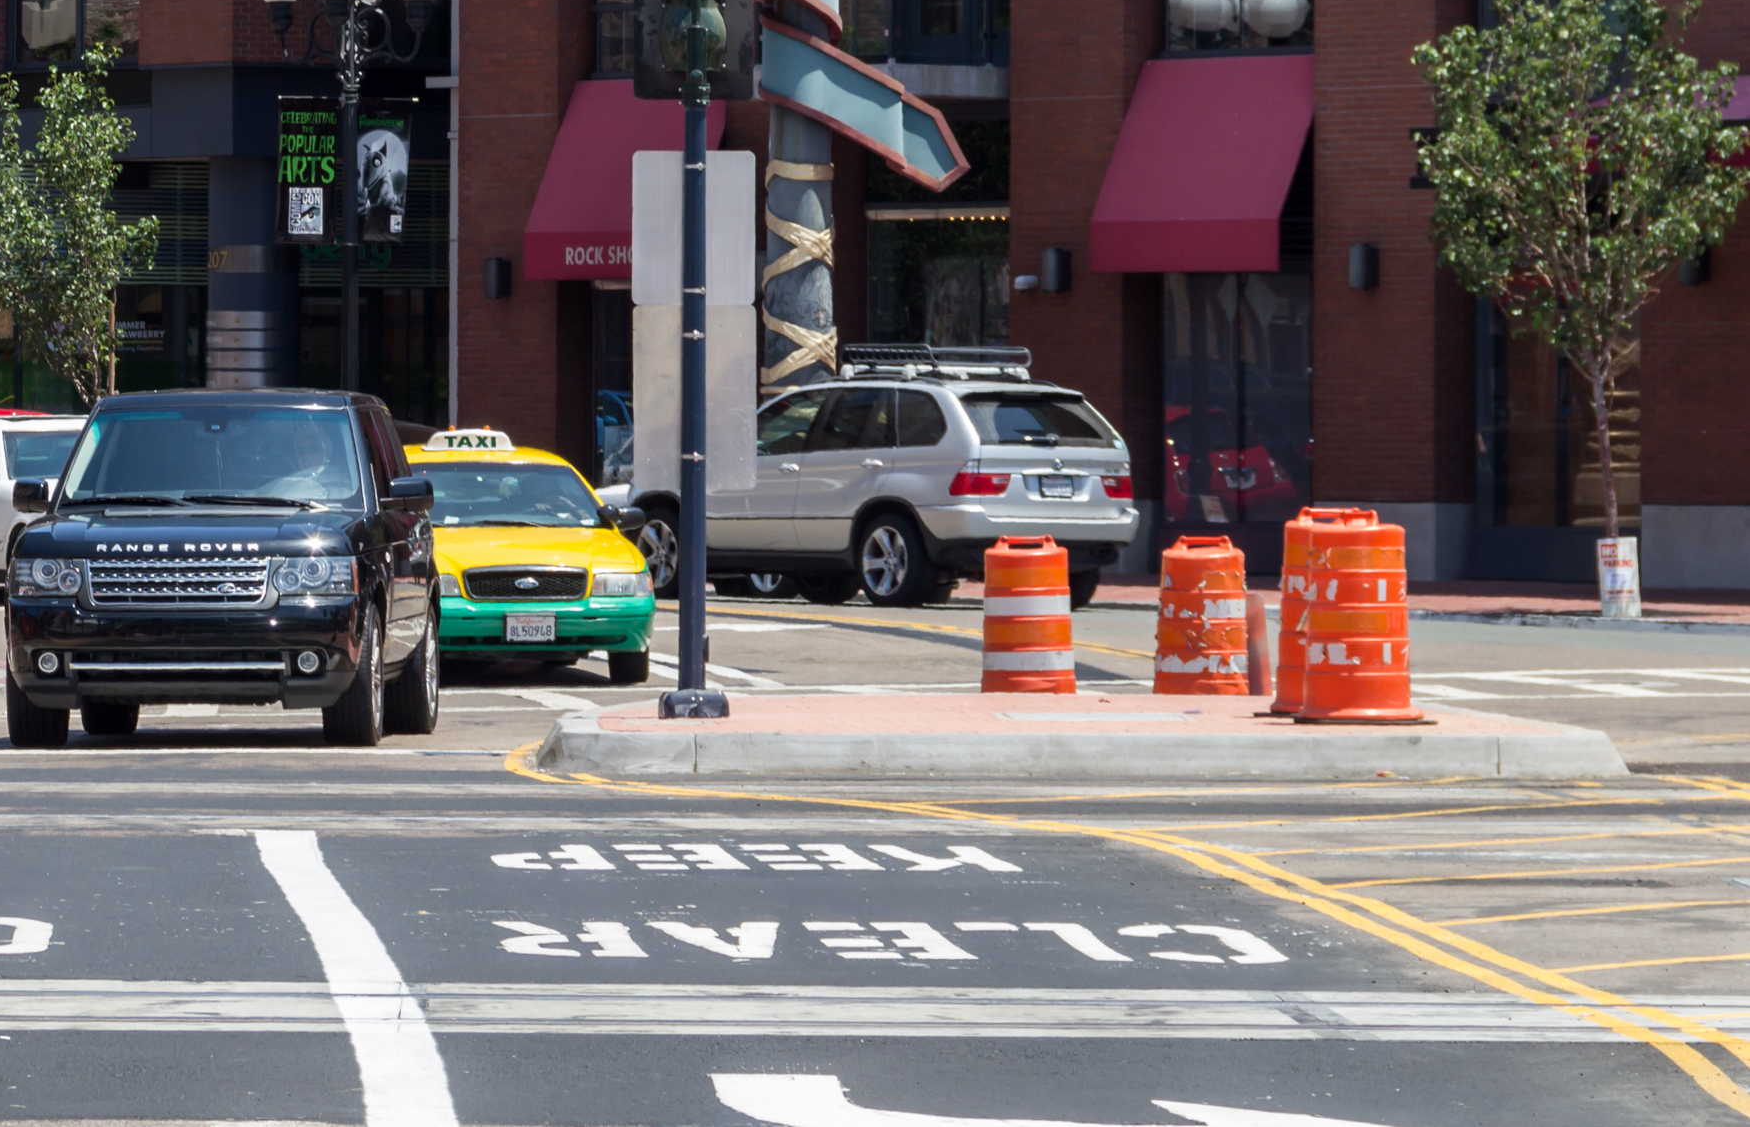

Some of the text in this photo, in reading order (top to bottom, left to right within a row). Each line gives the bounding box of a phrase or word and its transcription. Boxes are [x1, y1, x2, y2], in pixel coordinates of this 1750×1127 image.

[280, 112, 337, 124] CELEBRATING
[302, 126, 313, 134] THE
[279, 135, 336, 154] POPULAR
[278, 156, 336, 184] ARTS
[302, 192, 321, 204] CON
[290, 192, 301, 227] COMIC
[565, 246, 604, 265] ROCK
[444, 436, 497, 448] TAXI
[96, 543, 260, 552] RANGE ROVER
[1602, 545, 1616, 557] NO
[1603, 559, 1634, 567] PARKING
[510, 625, 552, 637] 8L50948
[490, 843, 1023, 872] KEEP
[491, 919, 1290, 965] CLEAR
